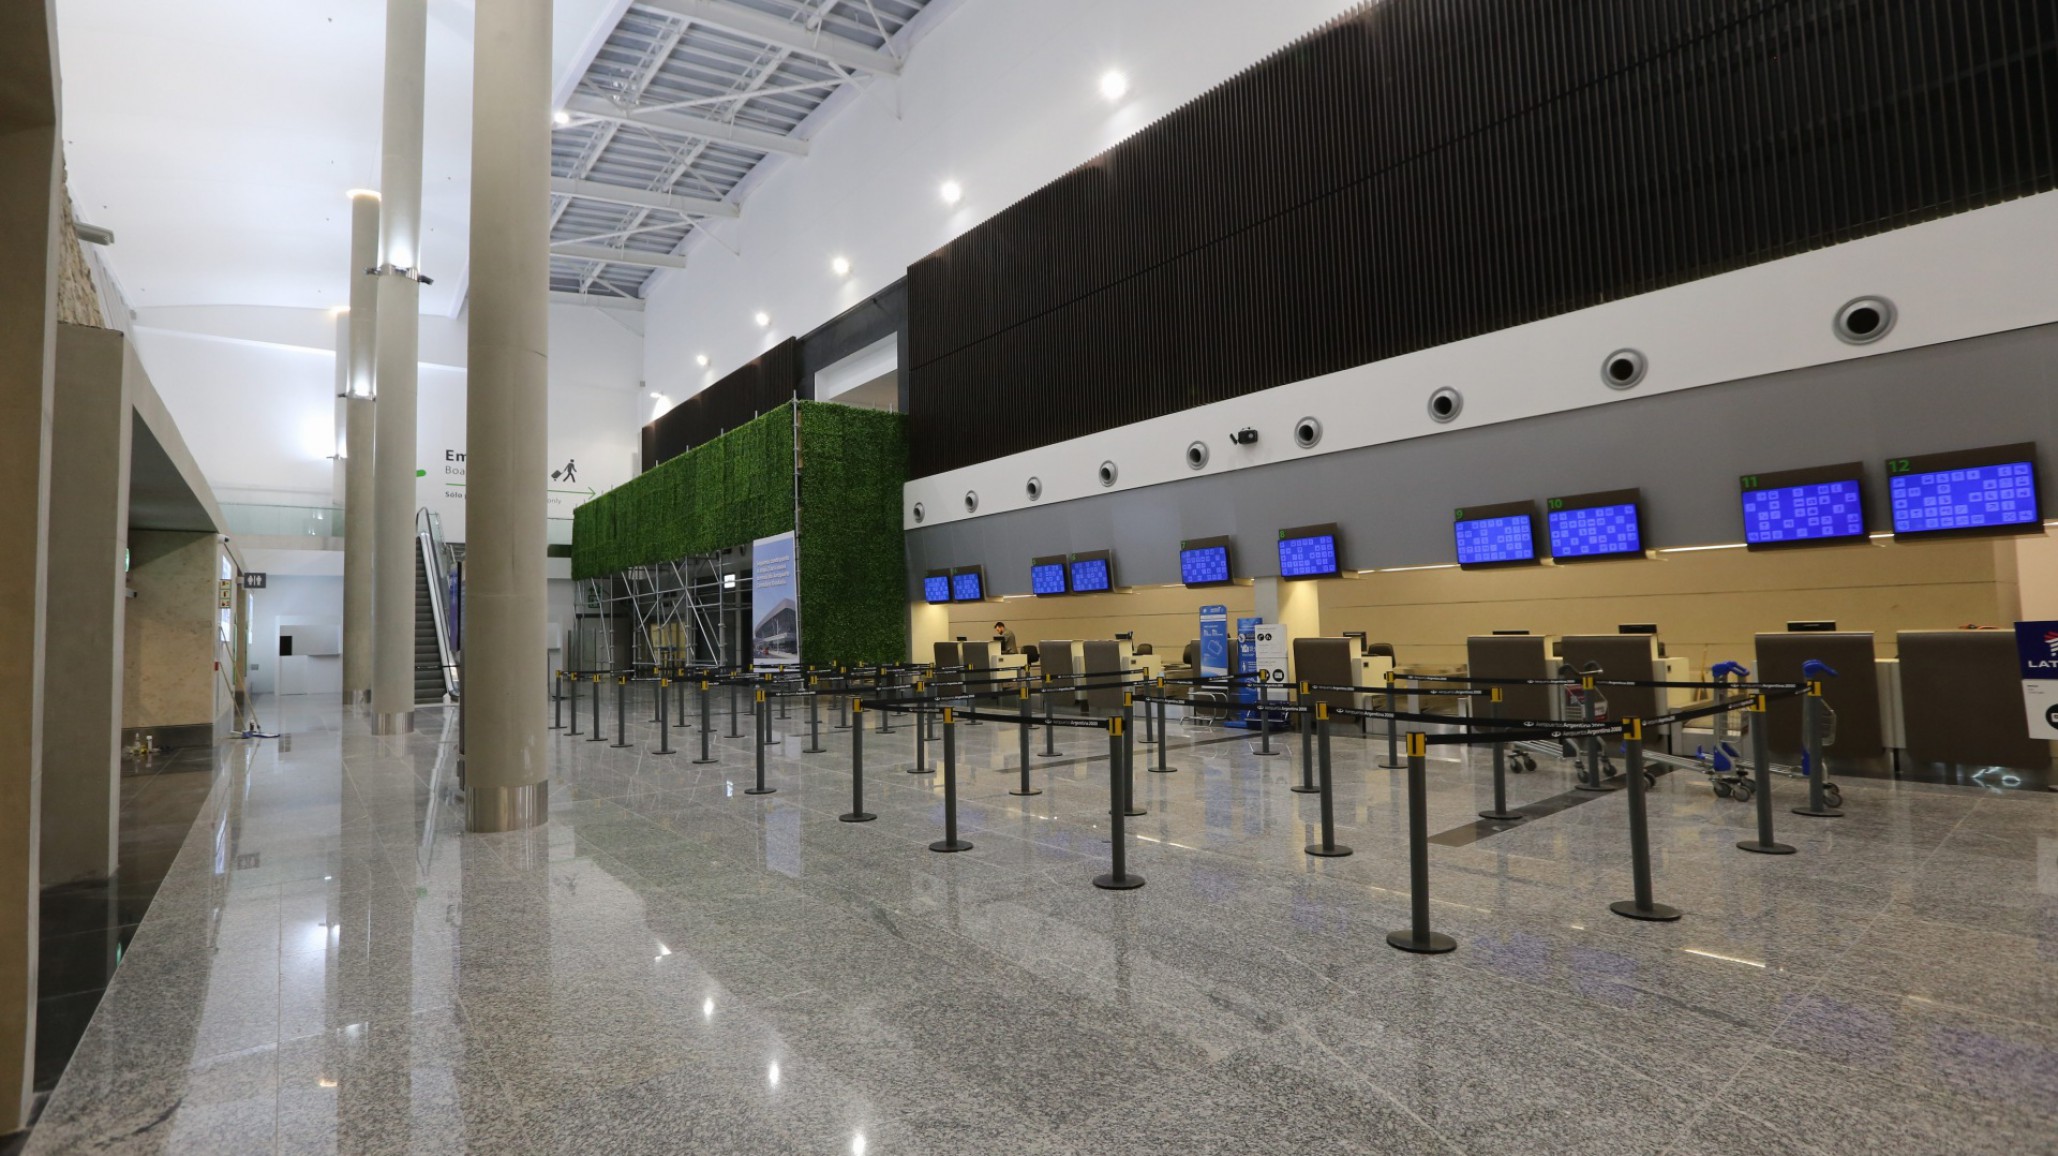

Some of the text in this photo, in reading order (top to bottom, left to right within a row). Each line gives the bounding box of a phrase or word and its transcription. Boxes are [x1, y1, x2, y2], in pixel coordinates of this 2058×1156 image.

[1888, 459, 1911, 473] 12
[1741, 476, 1759, 488] 11
[1549, 499, 1562, 509] 10
[1455, 509, 1463, 519] 9
[1279, 530, 1286, 538] 8
[2028, 660, 2058, 668] LAT
